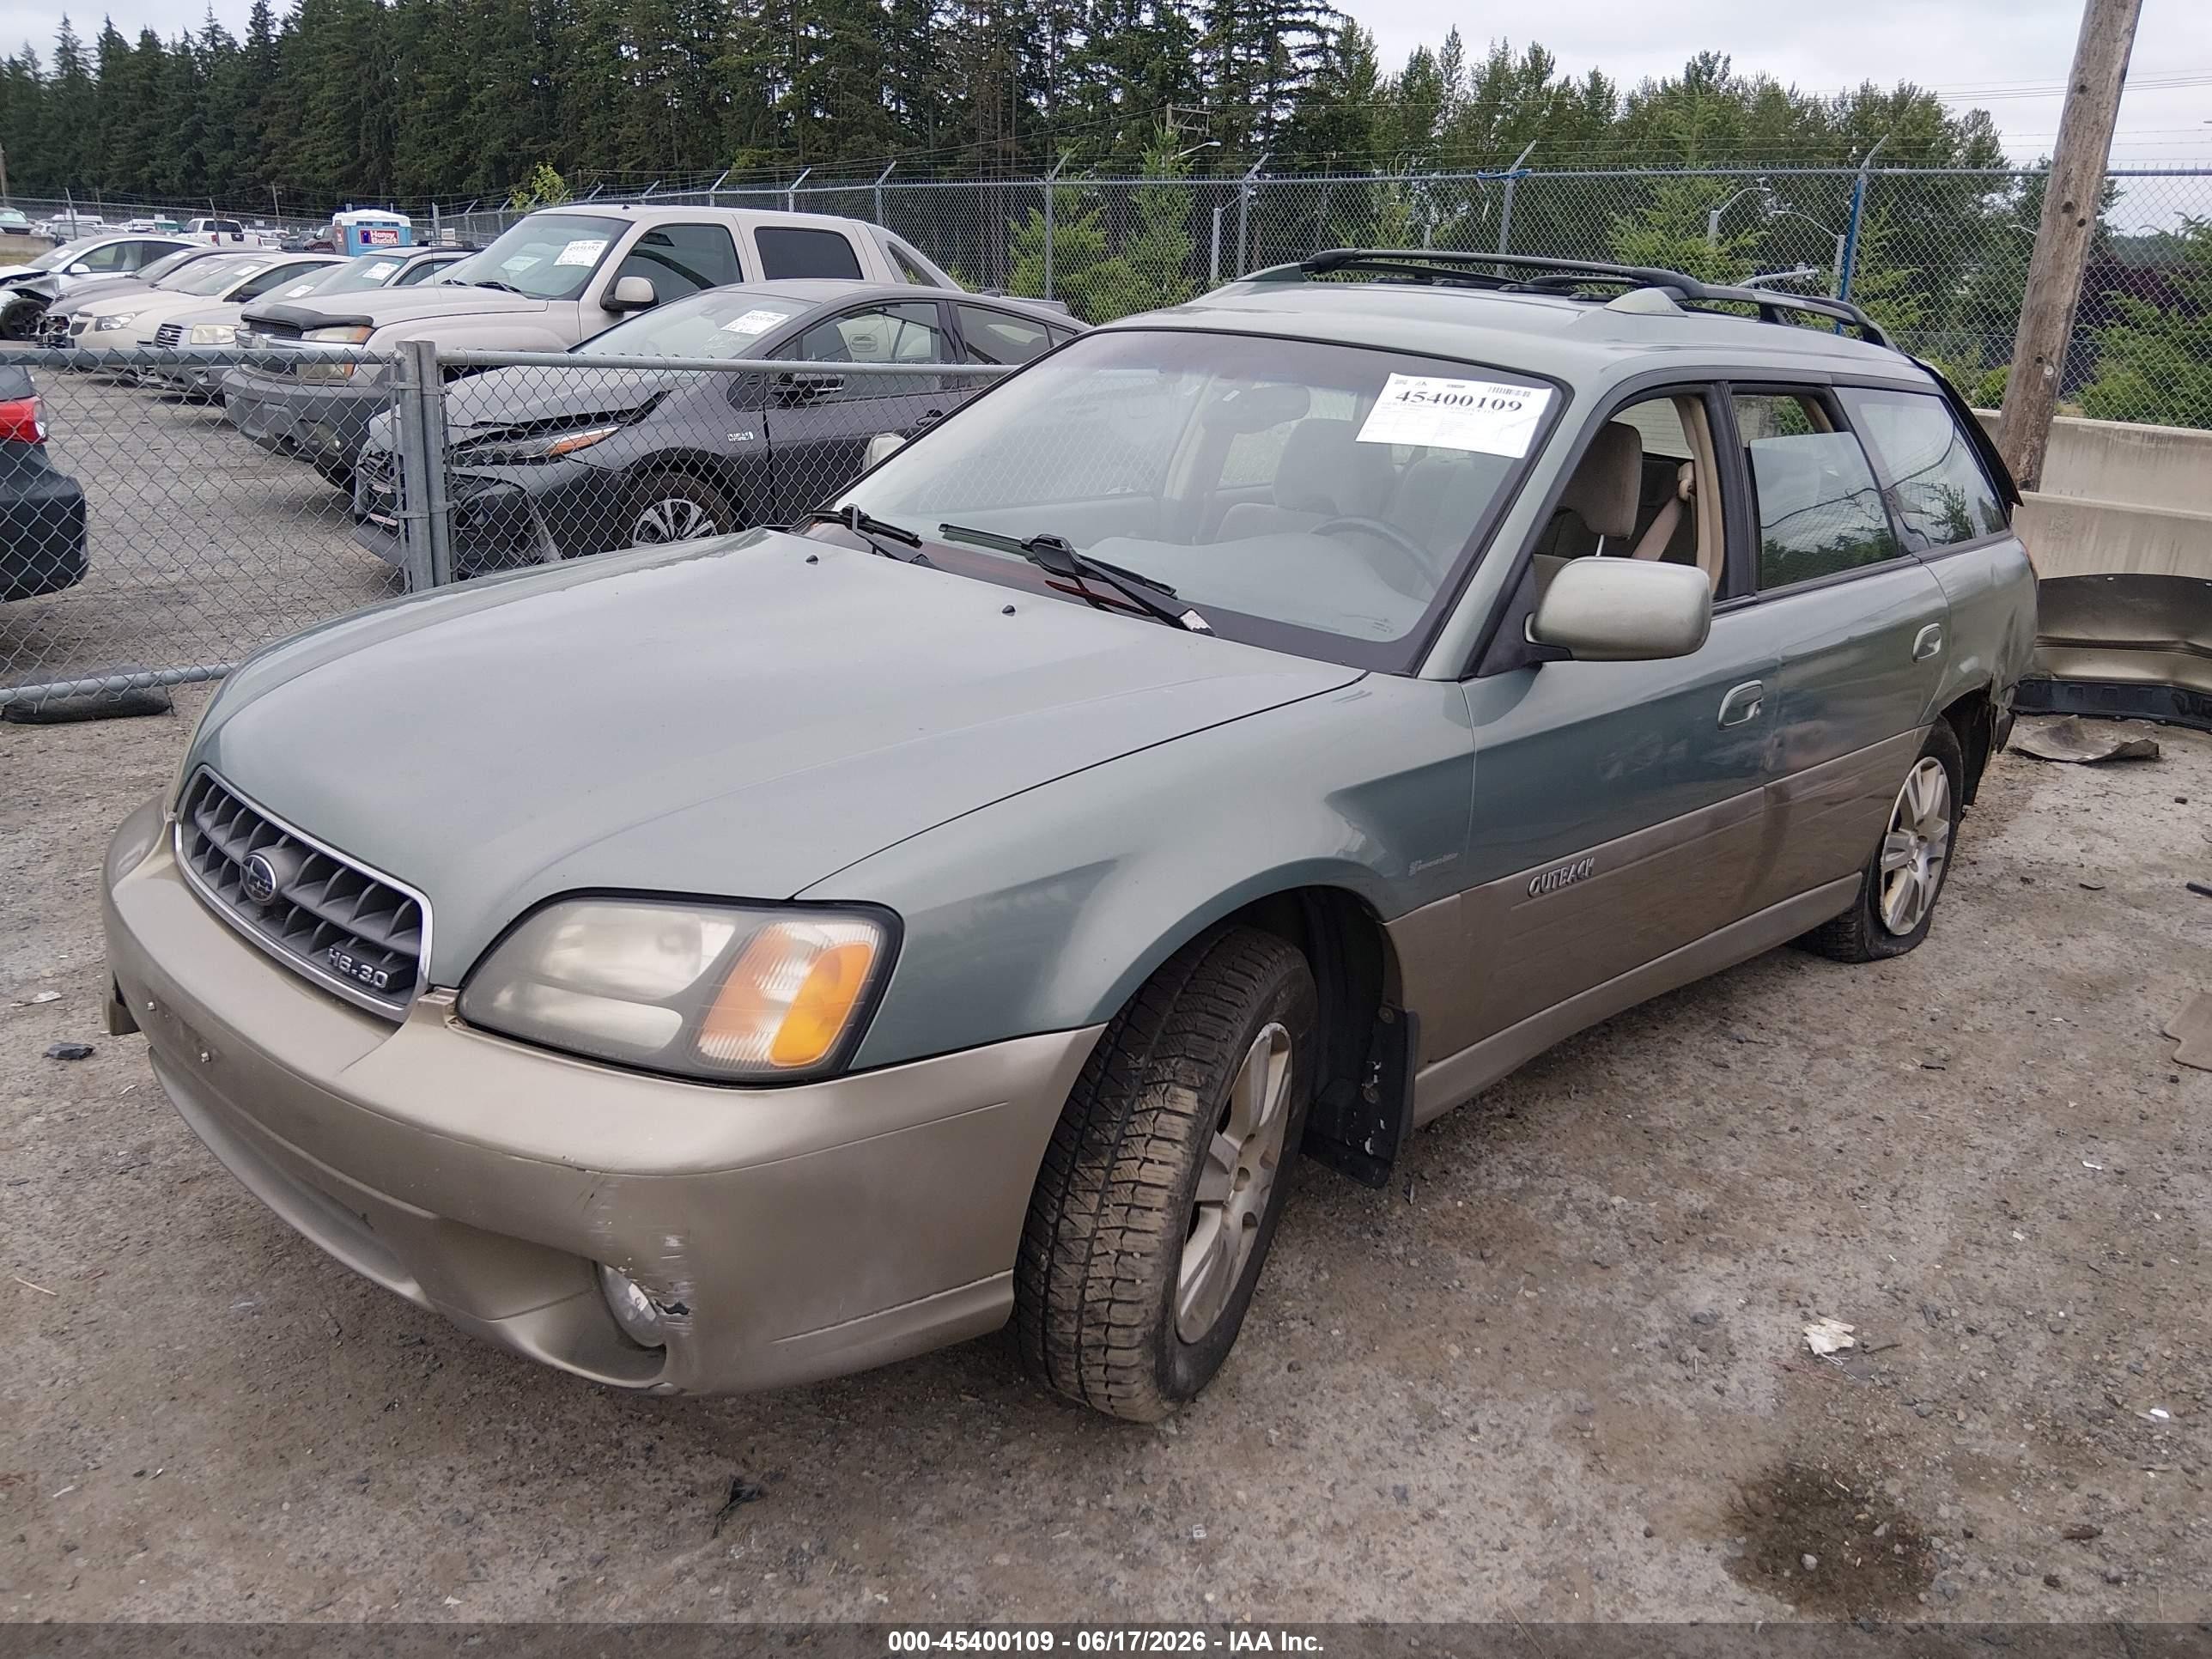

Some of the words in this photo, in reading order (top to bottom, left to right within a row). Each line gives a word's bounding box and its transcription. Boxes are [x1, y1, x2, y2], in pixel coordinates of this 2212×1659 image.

[370, 230, 395, 239] Honey
[1395, 390, 1523, 413] 45400109
[1528, 858, 1595, 897] OUTBACK
